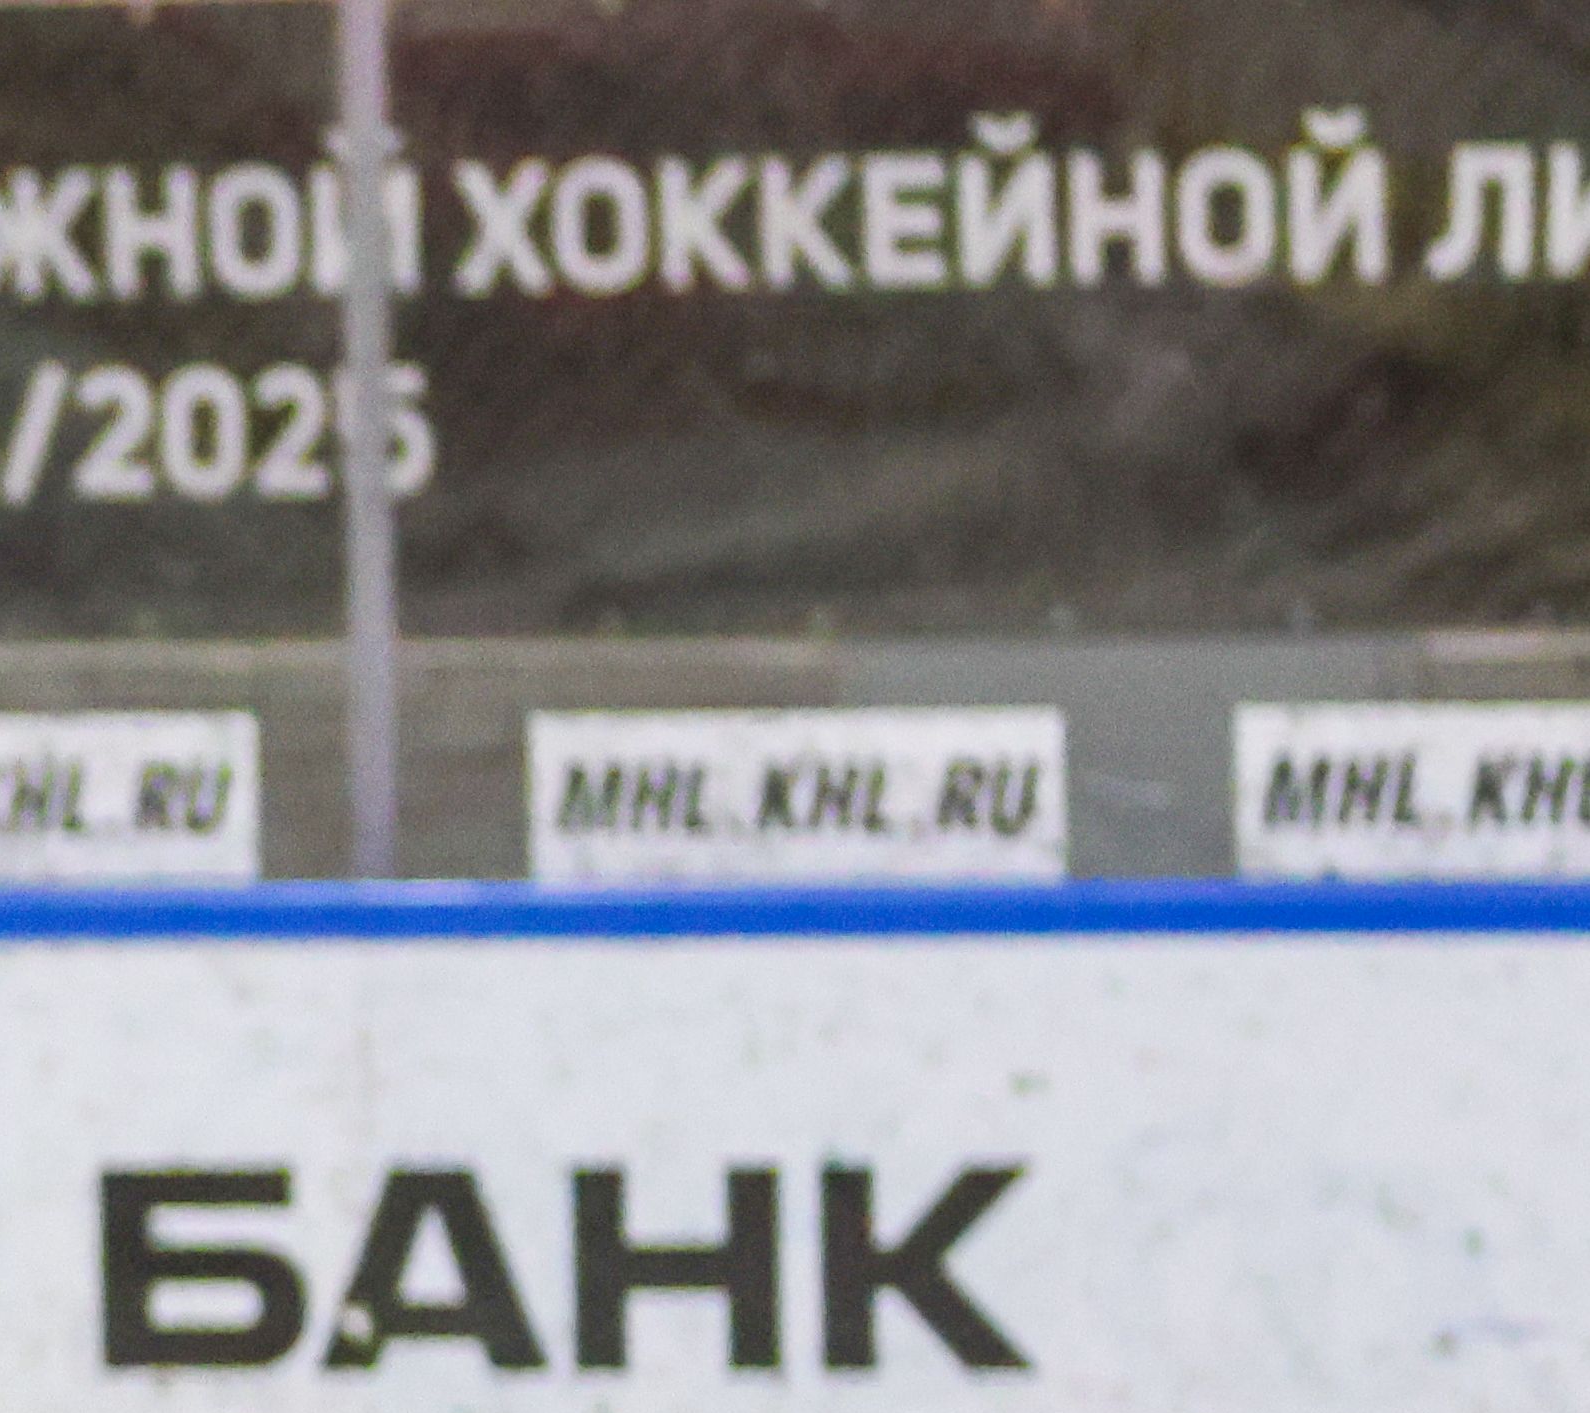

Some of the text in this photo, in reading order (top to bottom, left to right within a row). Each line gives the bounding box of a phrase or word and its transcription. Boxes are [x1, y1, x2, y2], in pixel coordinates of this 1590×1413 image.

[453, 107, 1388, 296] ХОККЕЙНОЙ
[556, 762, 1037, 836] MHL.KHL.RU
[99, 1160, 1037, 1372] БАНК
